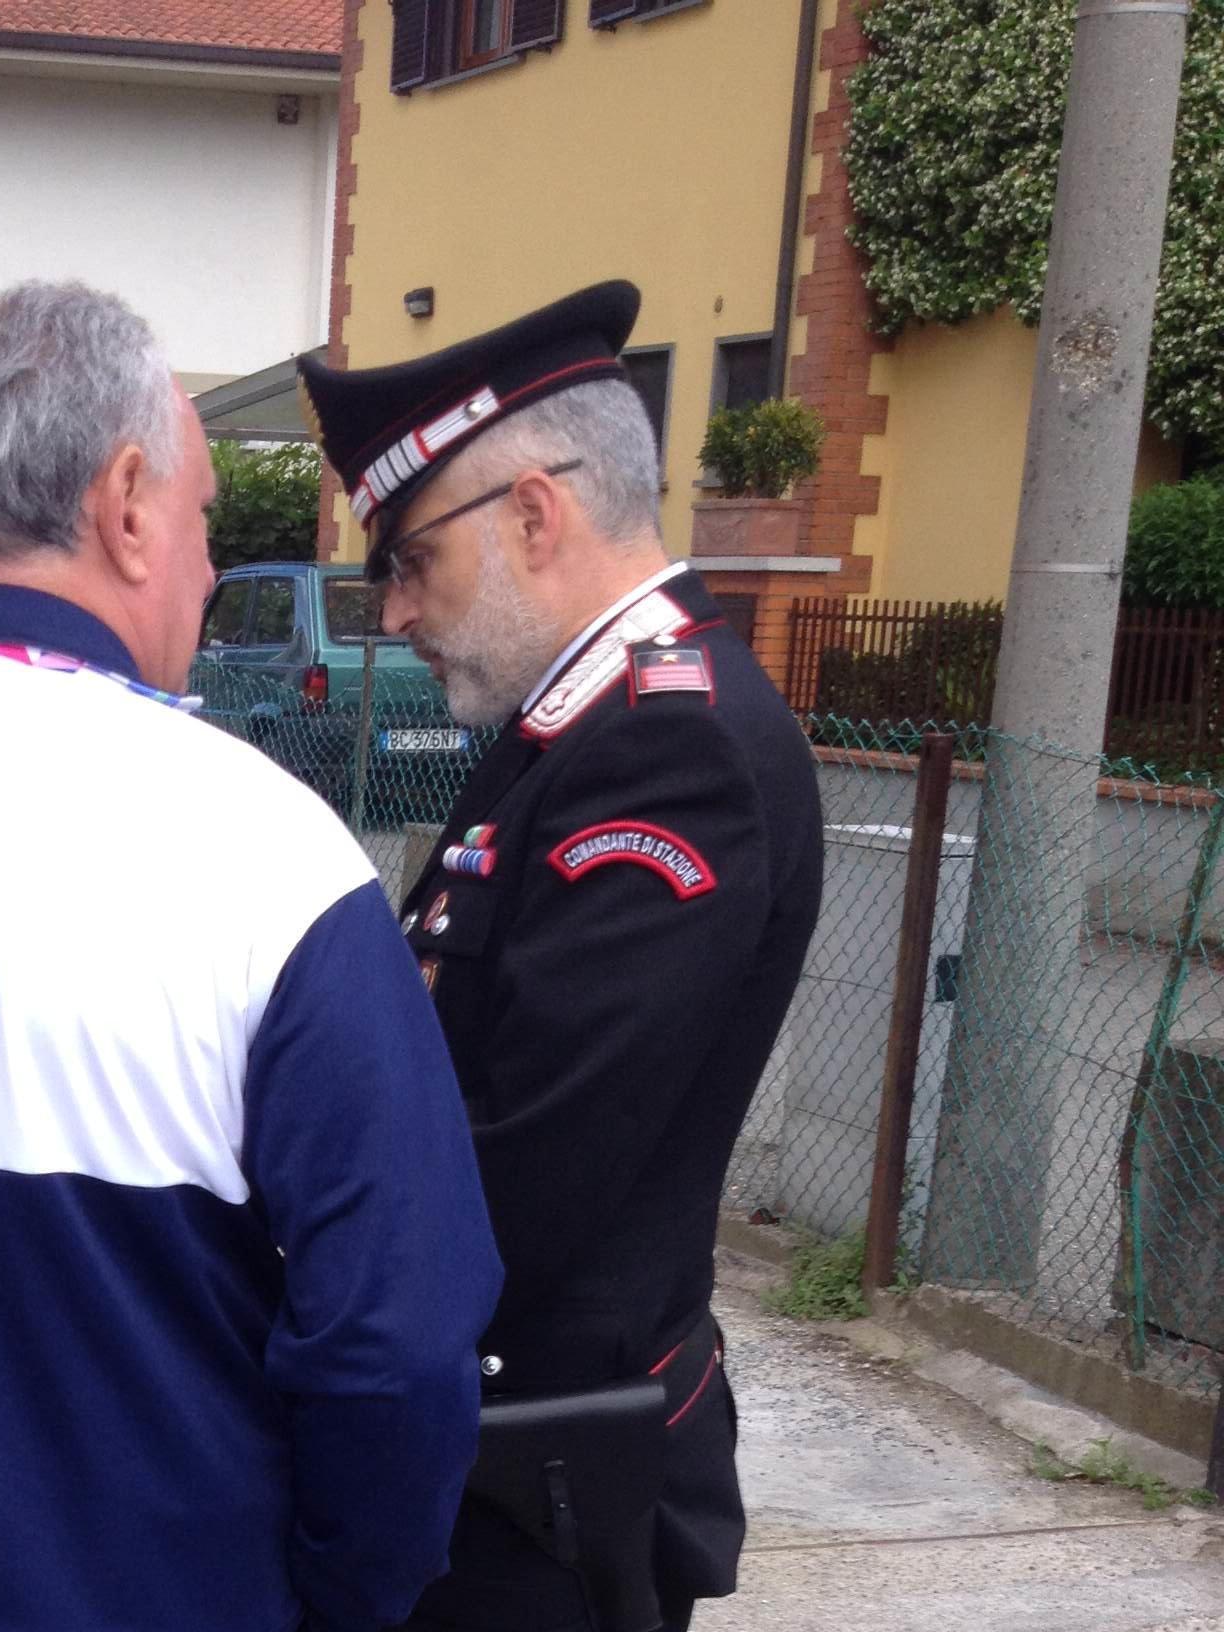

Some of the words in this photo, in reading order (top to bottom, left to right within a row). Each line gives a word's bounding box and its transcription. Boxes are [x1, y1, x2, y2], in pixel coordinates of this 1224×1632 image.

[563, 832, 643, 868] COMANDANTE
[641, 836, 657, 853] DI
[652, 840, 704, 888] STAZIONE
